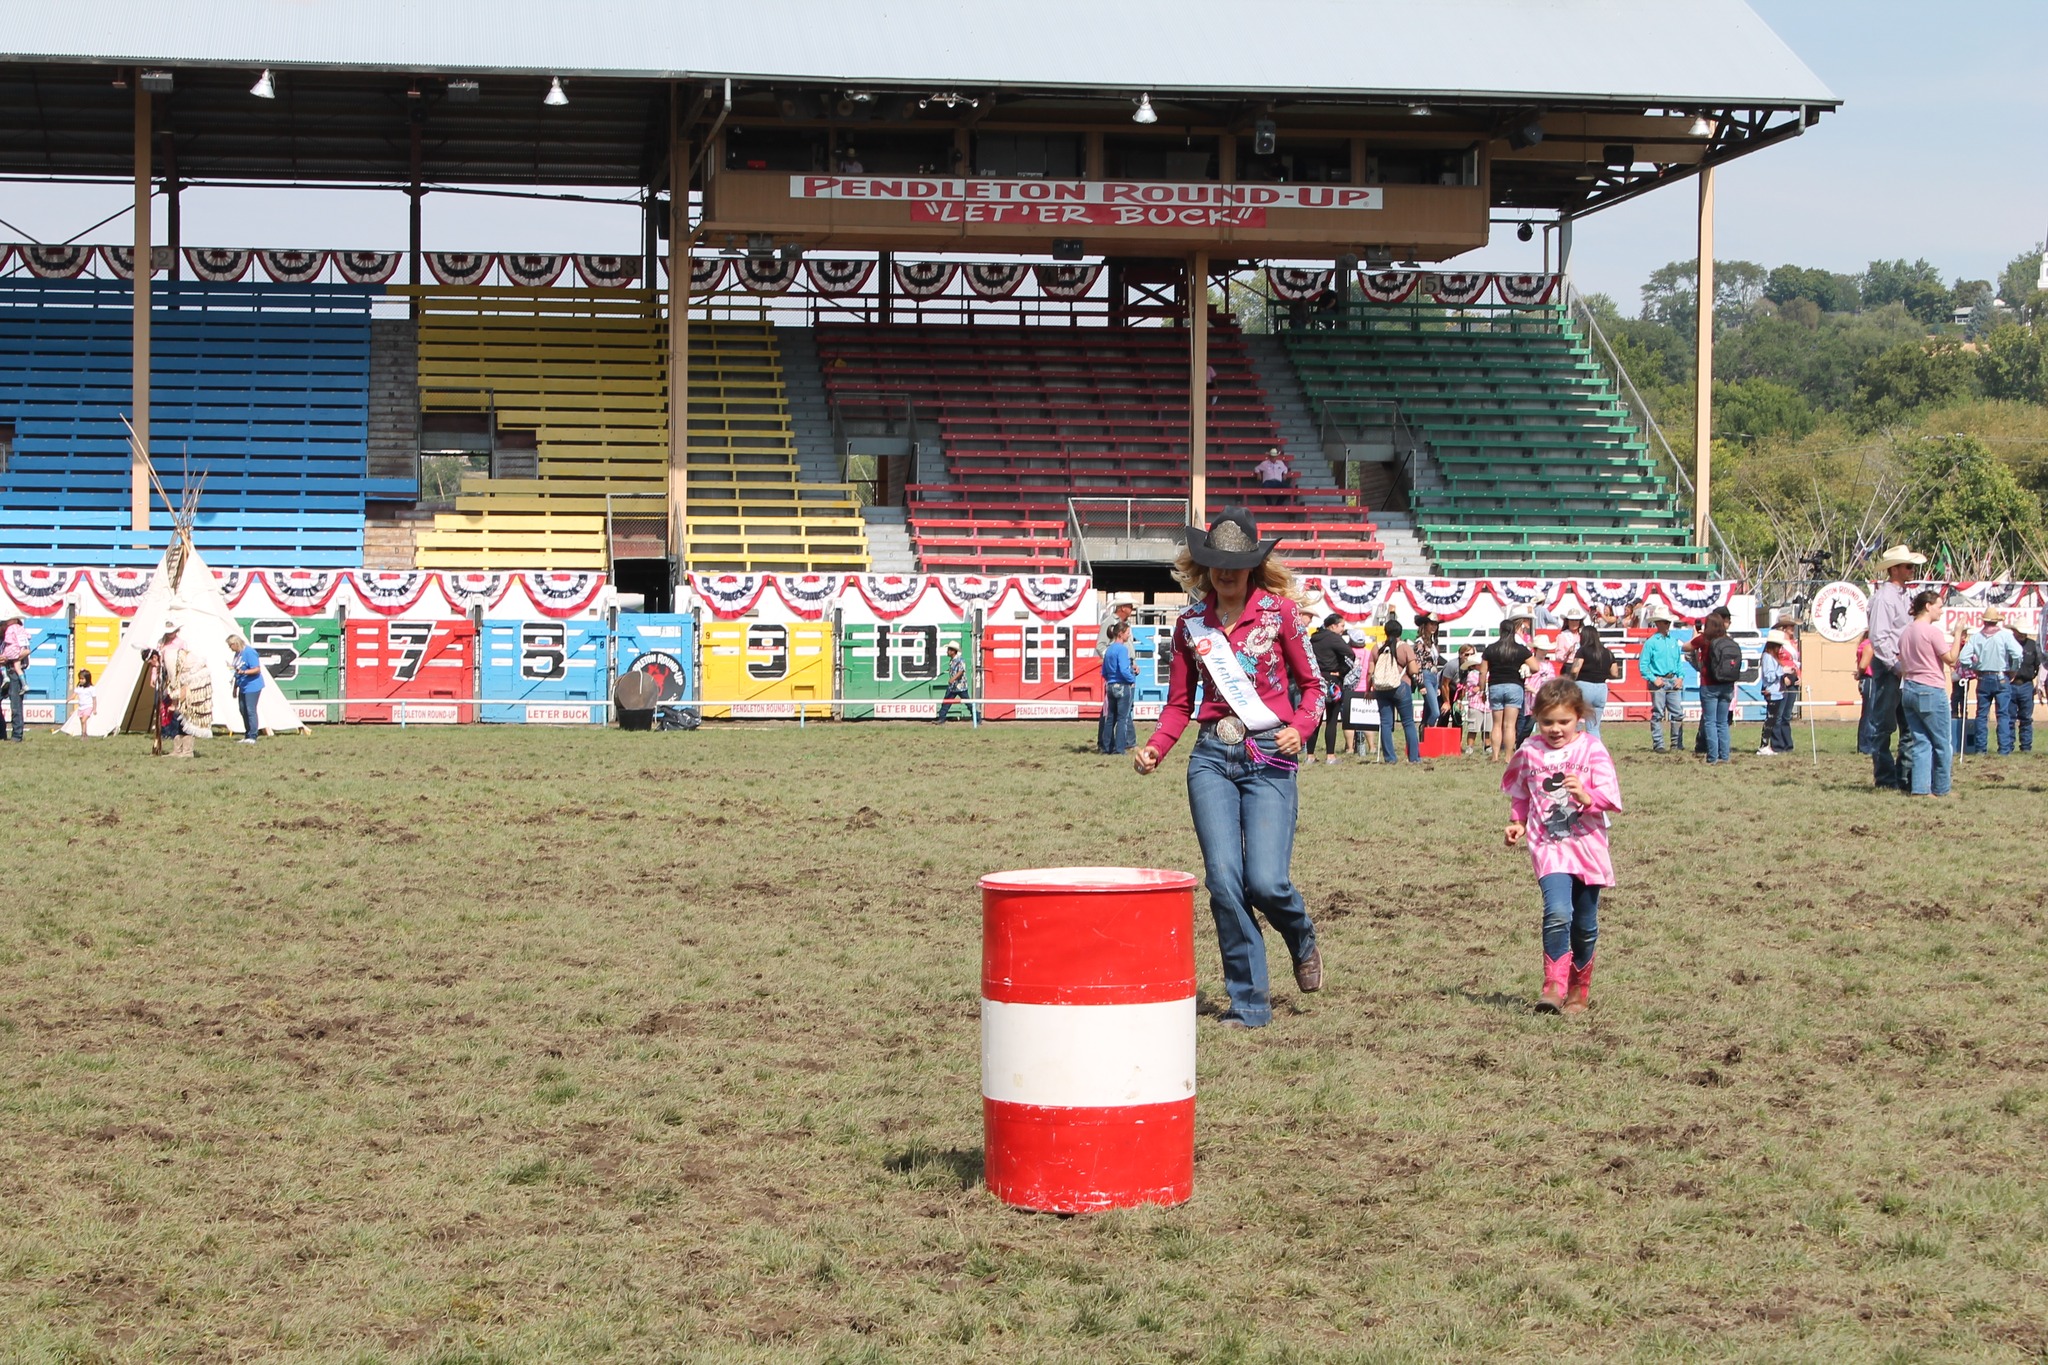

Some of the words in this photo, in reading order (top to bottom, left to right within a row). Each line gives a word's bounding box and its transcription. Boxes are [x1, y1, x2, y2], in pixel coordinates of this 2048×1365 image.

[803, 176, 1086, 201] PENDLETON
[1103, 183, 1370, 207] ROUND-UP
[157, 250, 169, 266] 2
[625, 259, 637, 276] 3
[1425, 276, 1436, 292] 5
[388, 620, 437, 681] 7
[520, 620, 567, 681] 8
[746, 623, 789, 681] 9
[874, 624, 940, 681] 10
[1022, 625, 1073, 683] 11
[1210, 653, 1248, 706] Montana
[26, 709, 53, 718] BUCK
[298, 708, 325, 718] BUCK
[394, 710, 426, 719] PEDLETON
[427, 709, 457, 719] ROUND-UP
[528, 710, 560, 719] LET'ER
[563, 710, 589, 719] BUCK
[732, 704, 765, 713] PENDLETON
[766, 704, 795, 713] ROUND-UP
[875, 705, 907, 714] LET'ER
[909, 705, 935, 714] BUCK
[1016, 706, 1048, 716] PENDLETON
[1050, 706, 1078, 716] ROUND-UP
[1135, 706, 1160, 715] LET'E
[1566, 761, 1589, 773] RODEO
